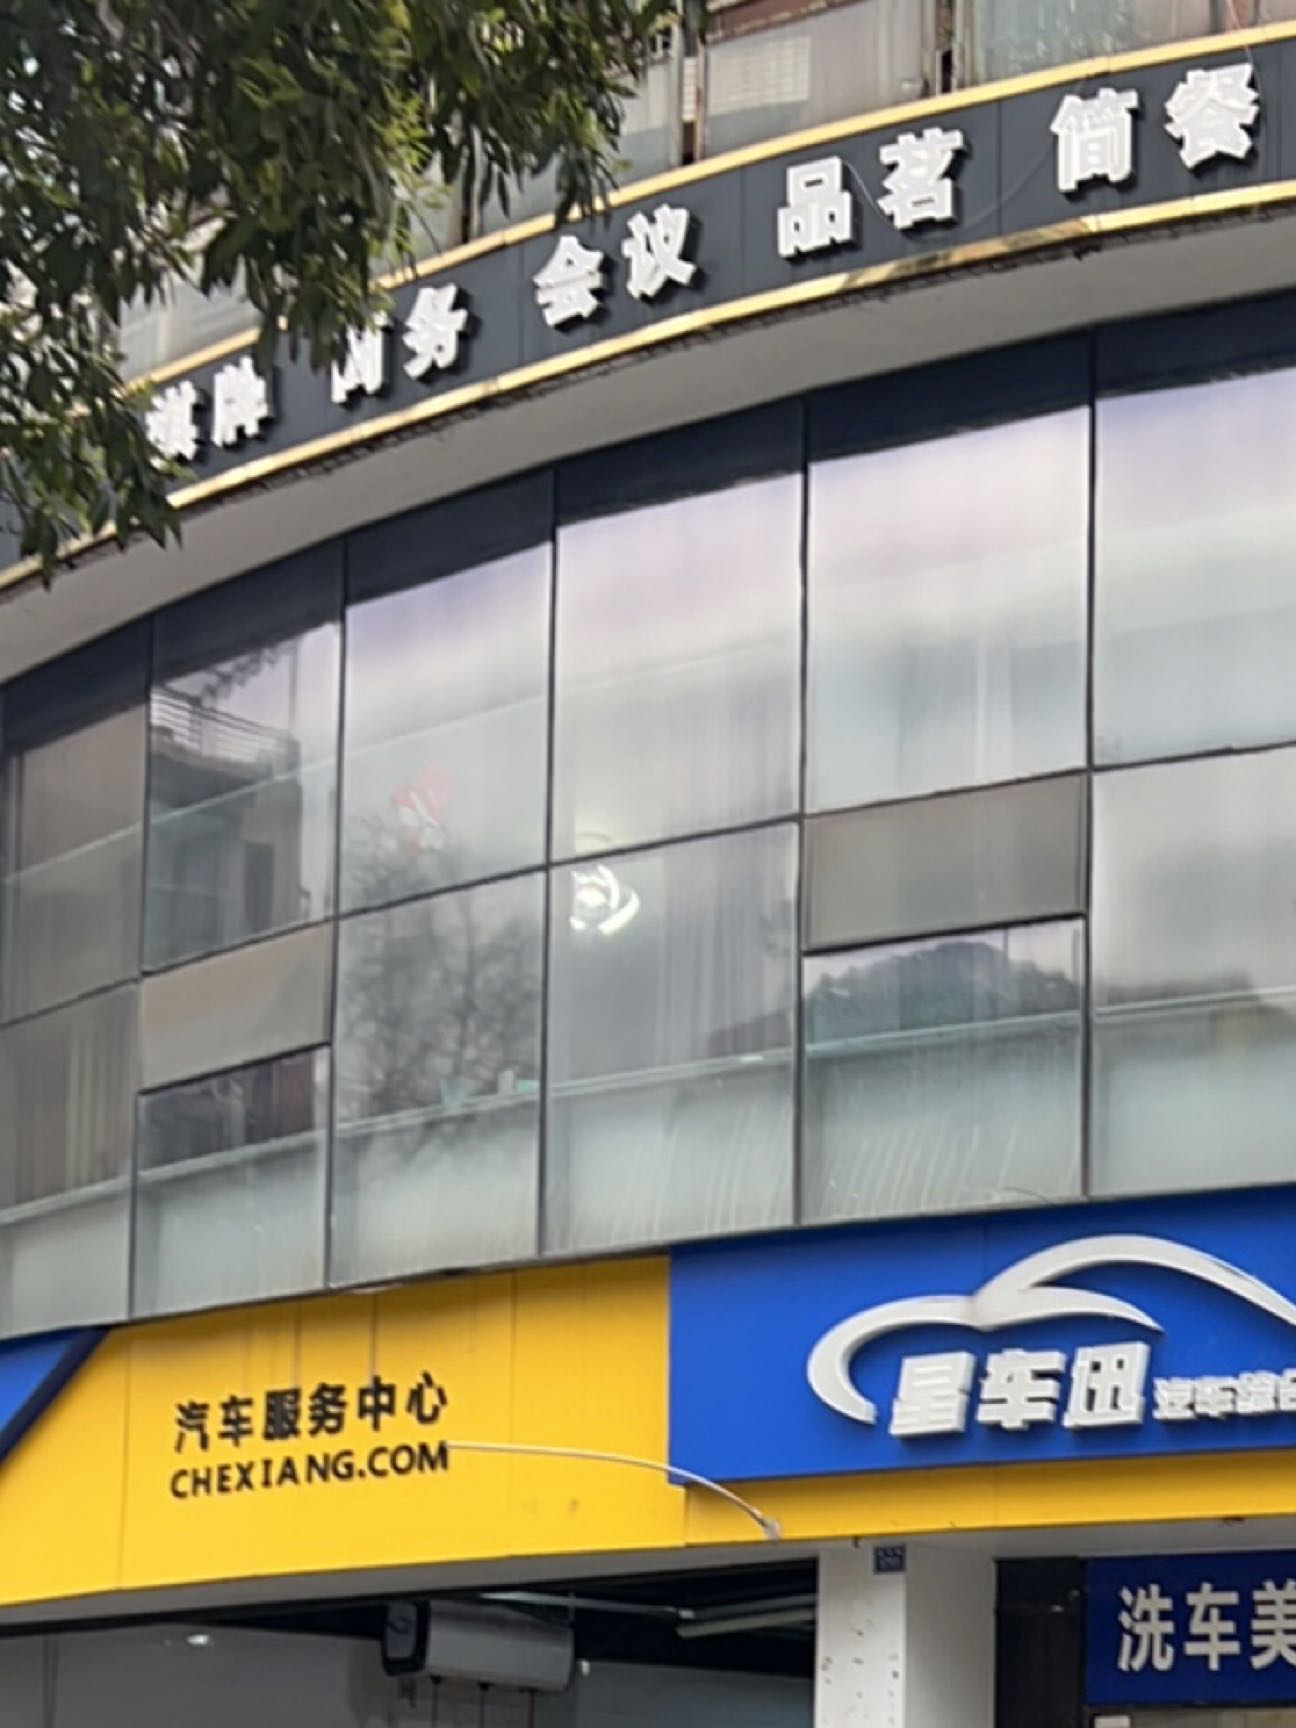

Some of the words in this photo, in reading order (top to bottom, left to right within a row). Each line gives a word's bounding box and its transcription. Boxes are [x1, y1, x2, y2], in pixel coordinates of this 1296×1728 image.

[533, 203, 697, 328] 会议
[777, 128, 964, 258] 品茗
[1051, 63, 1260, 192] 简餐
[174, 1371, 448, 1453] 汽车服务中心
[170, 1441, 449, 1499] CHEXIANG.COM
